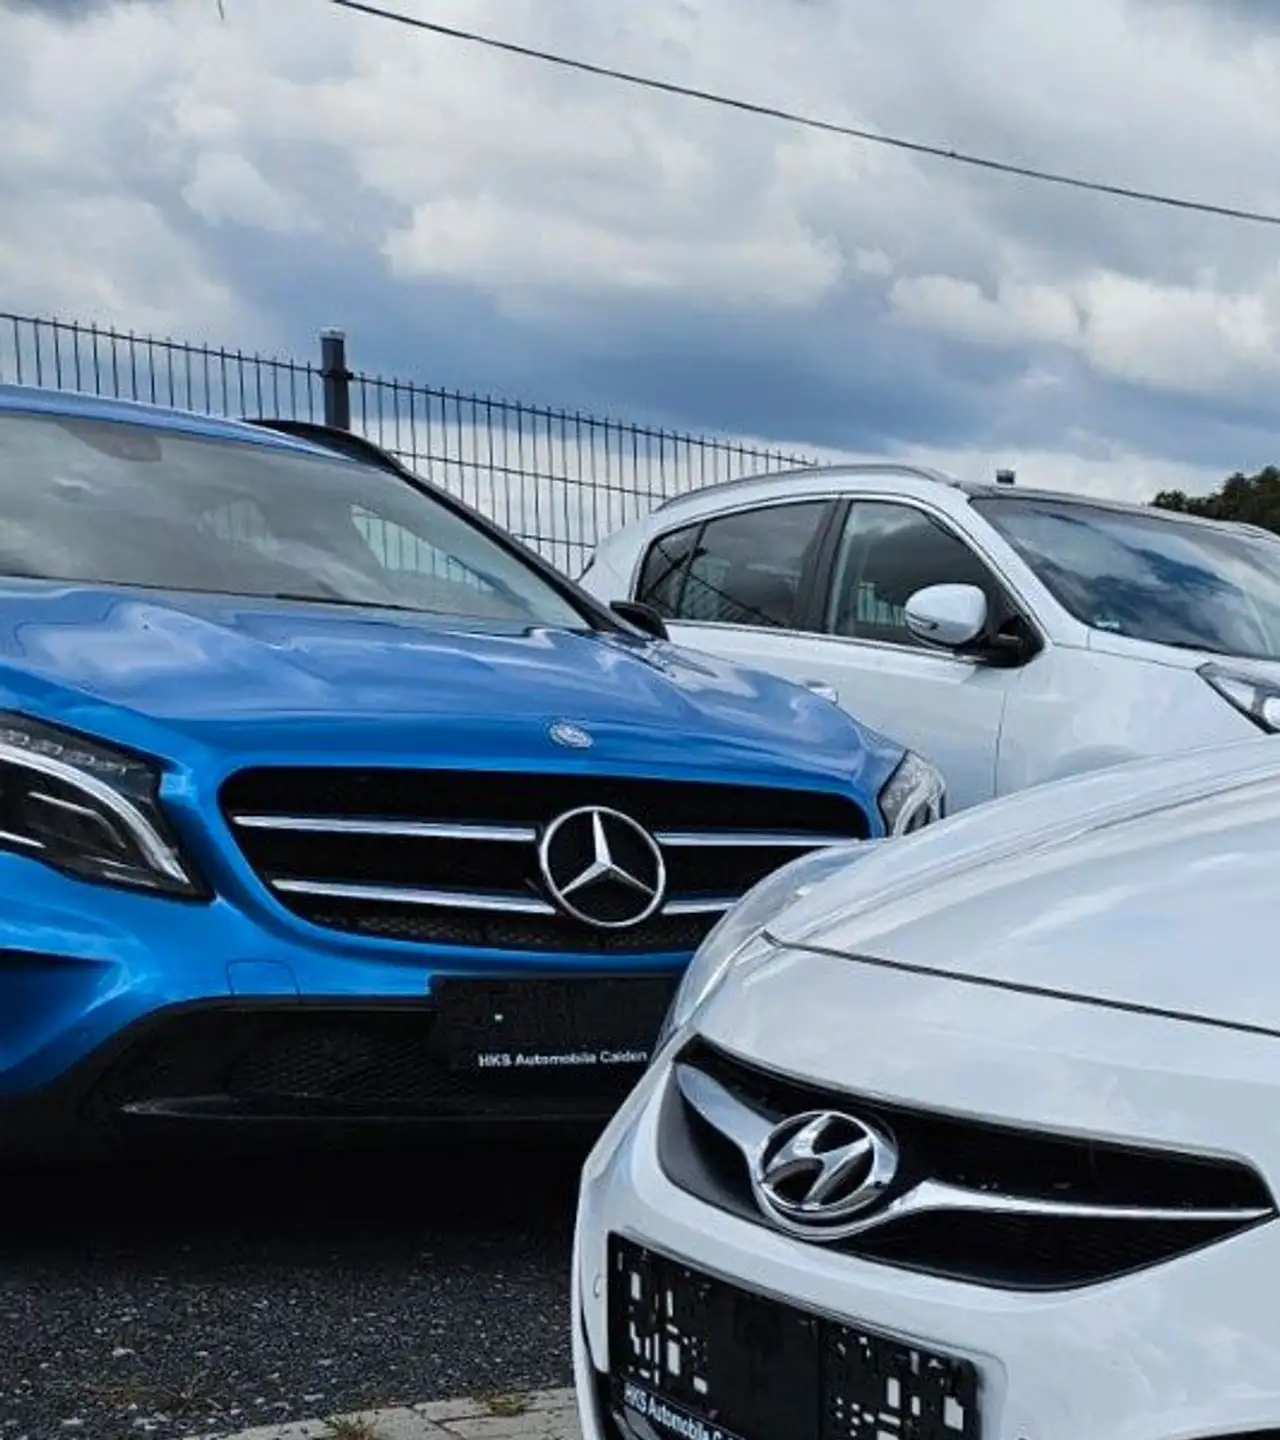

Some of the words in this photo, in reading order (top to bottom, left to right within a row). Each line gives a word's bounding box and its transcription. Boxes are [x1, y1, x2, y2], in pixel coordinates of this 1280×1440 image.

[479, 1053, 511, 1067] HKS
[515, 1052, 597, 1066] Automobile
[600, 1050, 648, 1064] Calden
